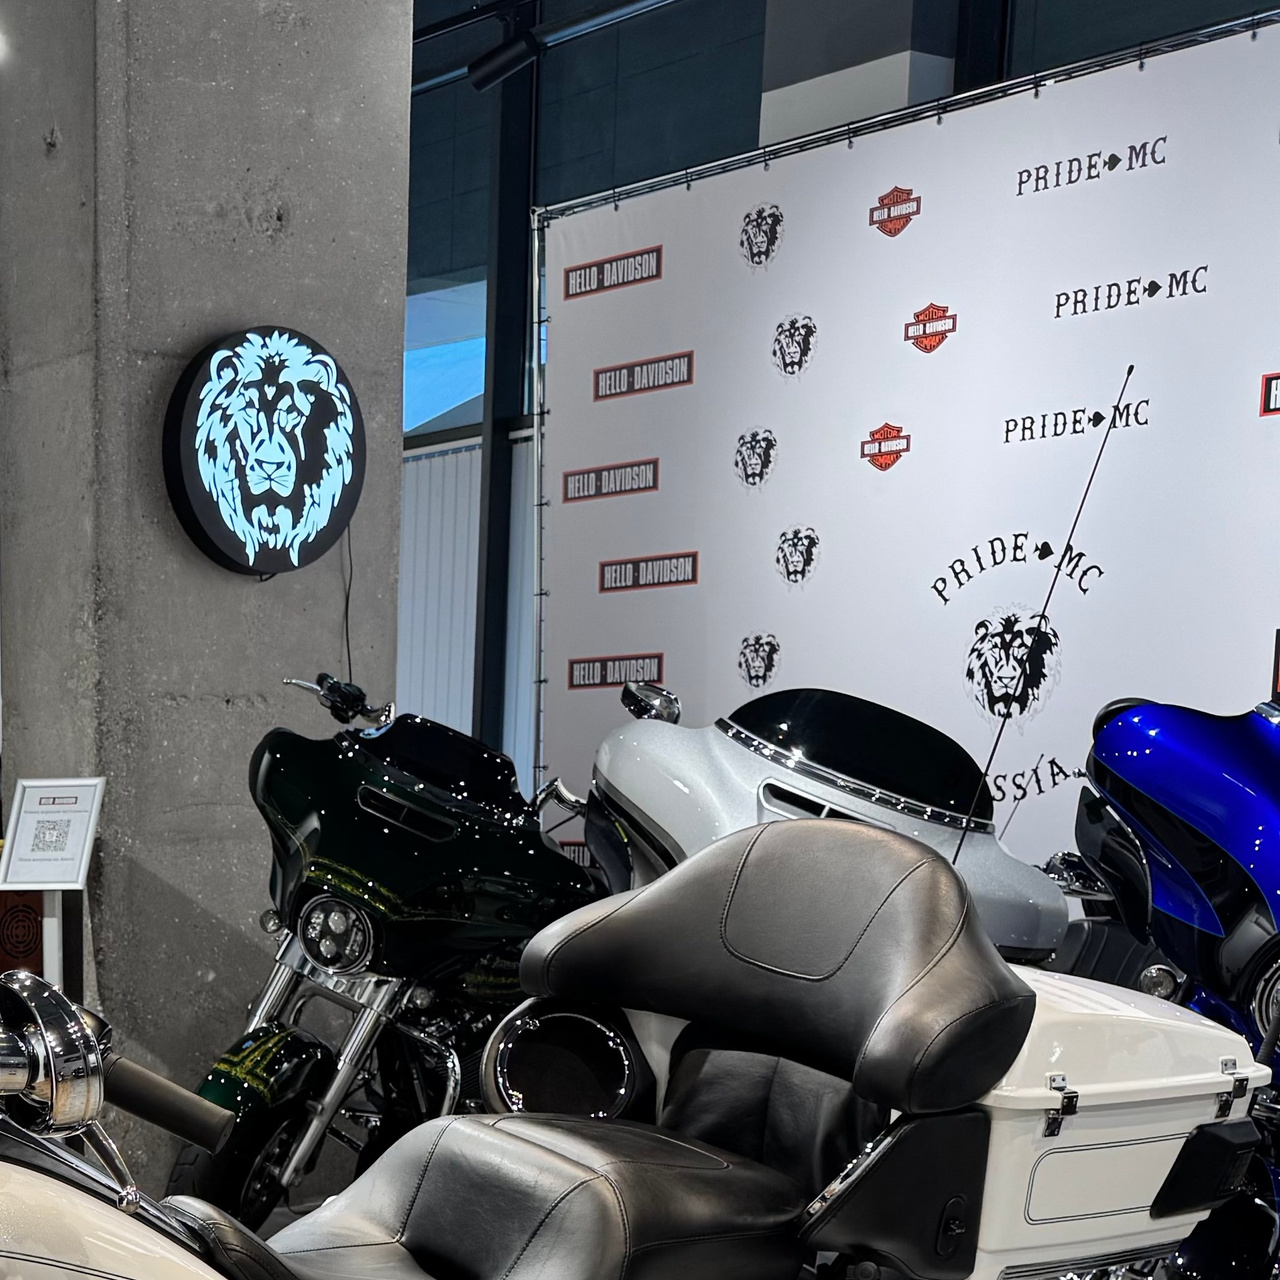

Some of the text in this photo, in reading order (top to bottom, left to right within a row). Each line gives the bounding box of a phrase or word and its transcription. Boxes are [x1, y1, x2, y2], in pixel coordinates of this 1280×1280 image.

[1016, 135, 1168, 197] PRIDE MC
[569, 252, 657, 295] HELLO DAVIDSON
[1054, 264, 1209, 319] PRIDE MC
[598, 357, 688, 396] HELLO DAVIDSON
[1003, 399, 1150, 444] PRIDE MC
[567, 464, 654, 499] HELLO DAVIDSON
[604, 557, 693, 589] HELLO DAVIDSON
[930, 531, 1105, 606] PRIDE MC
[573, 658, 659, 686] HELLO DAVIDSON
[984, 757, 1071, 803] SSIA
